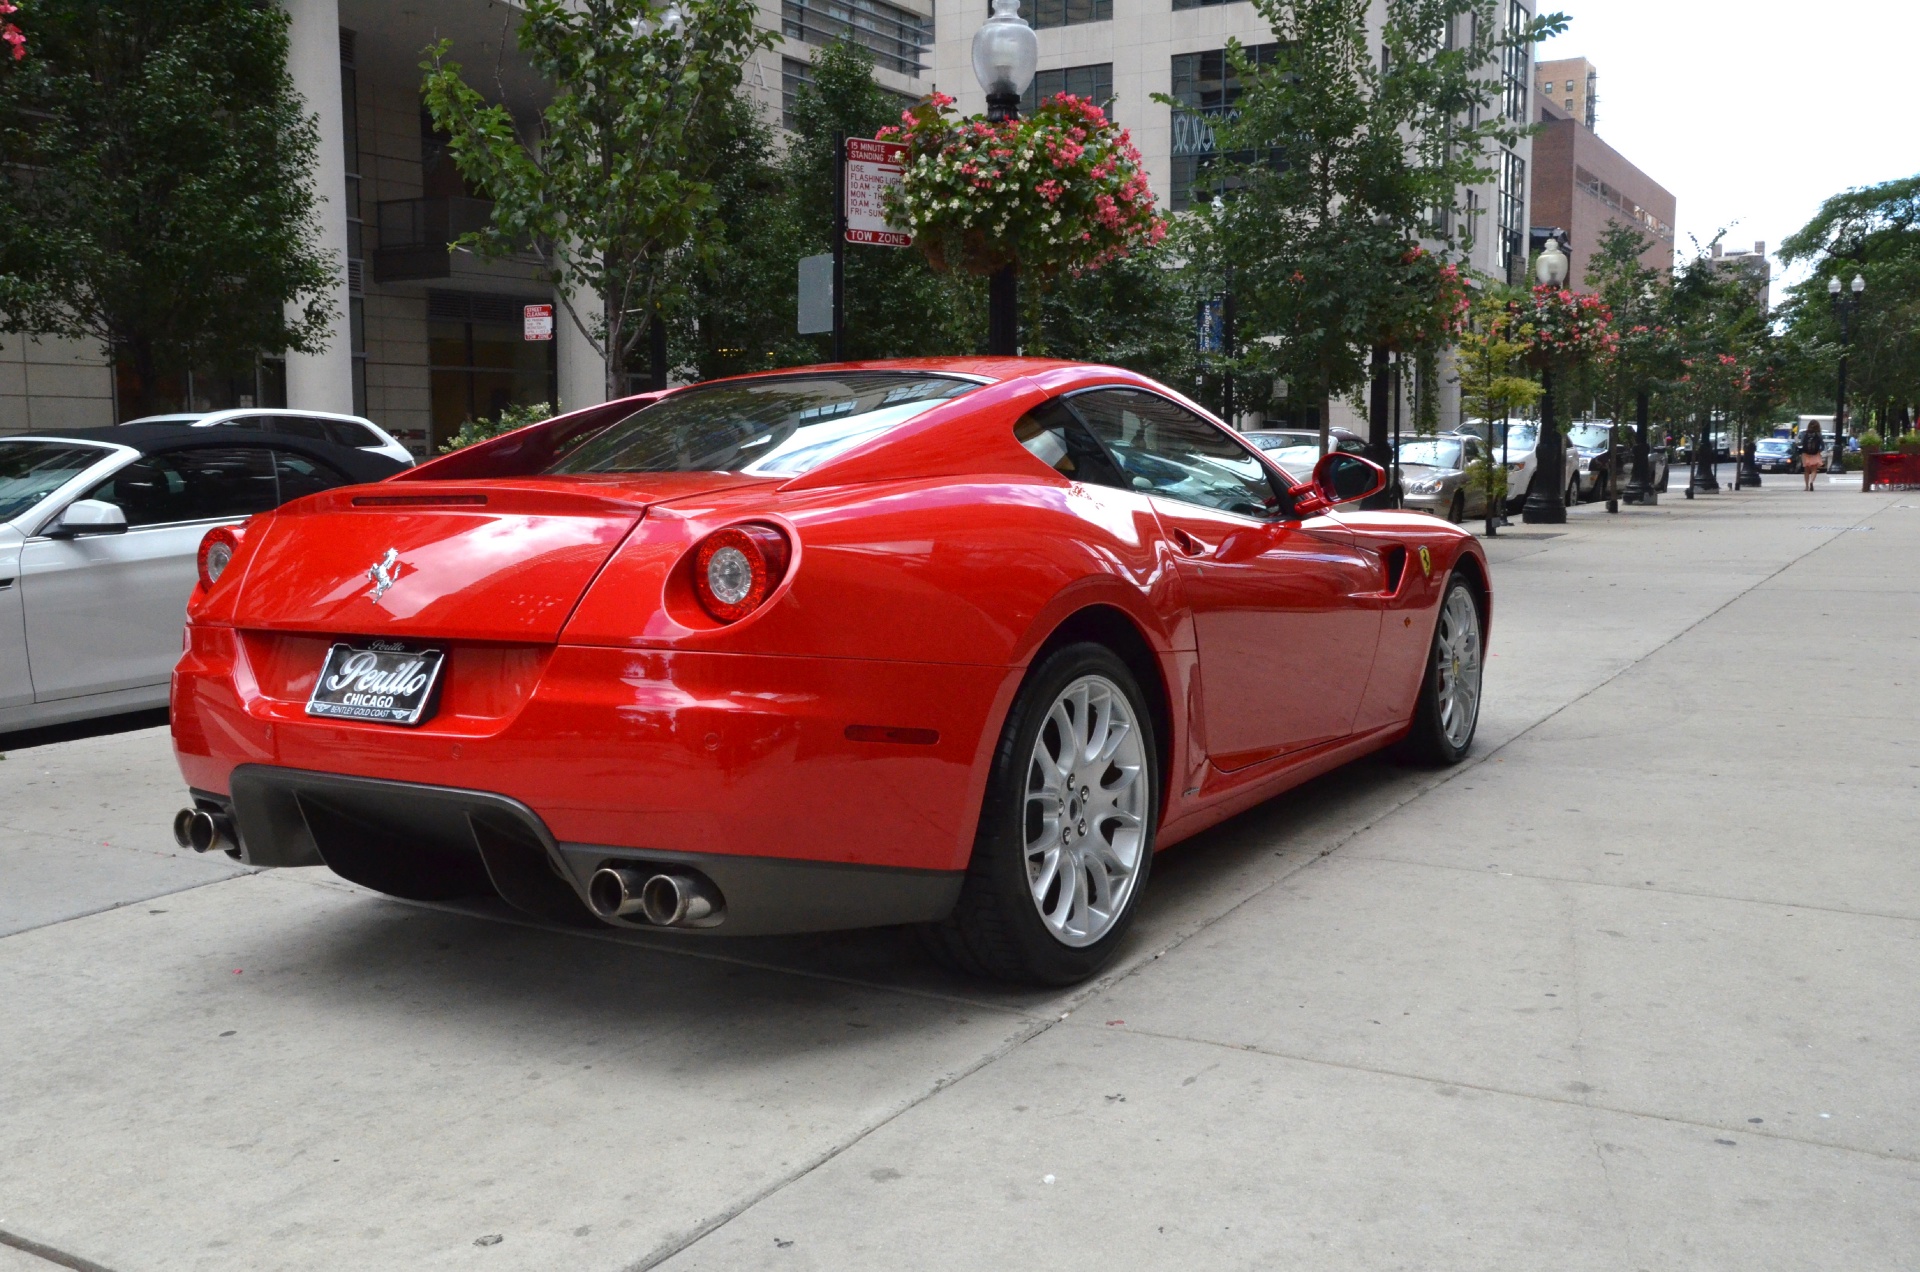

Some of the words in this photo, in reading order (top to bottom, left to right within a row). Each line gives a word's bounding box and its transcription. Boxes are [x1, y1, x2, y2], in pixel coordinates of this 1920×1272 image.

[851, 142, 858, 150] 15
[860, 143, 885, 154] MINUTE
[851, 150, 884, 162] STANDING
[851, 164, 865, 173] USE
[851, 173, 884, 184] FLASHING
[851, 190, 866, 198] MON
[851, 207, 862, 216] FRI
[851, 230, 872, 241] TOW
[878, 233, 905, 244] ZONE
[368, 640, 405, 651] Perillo
[326, 652, 427, 697] Perillo
[343, 693, 394, 708] CHICAGO
[330, 705, 354, 715] BENTLEY
[354, 707, 370, 716] GOLD
[370, 708, 391, 717] COAST
